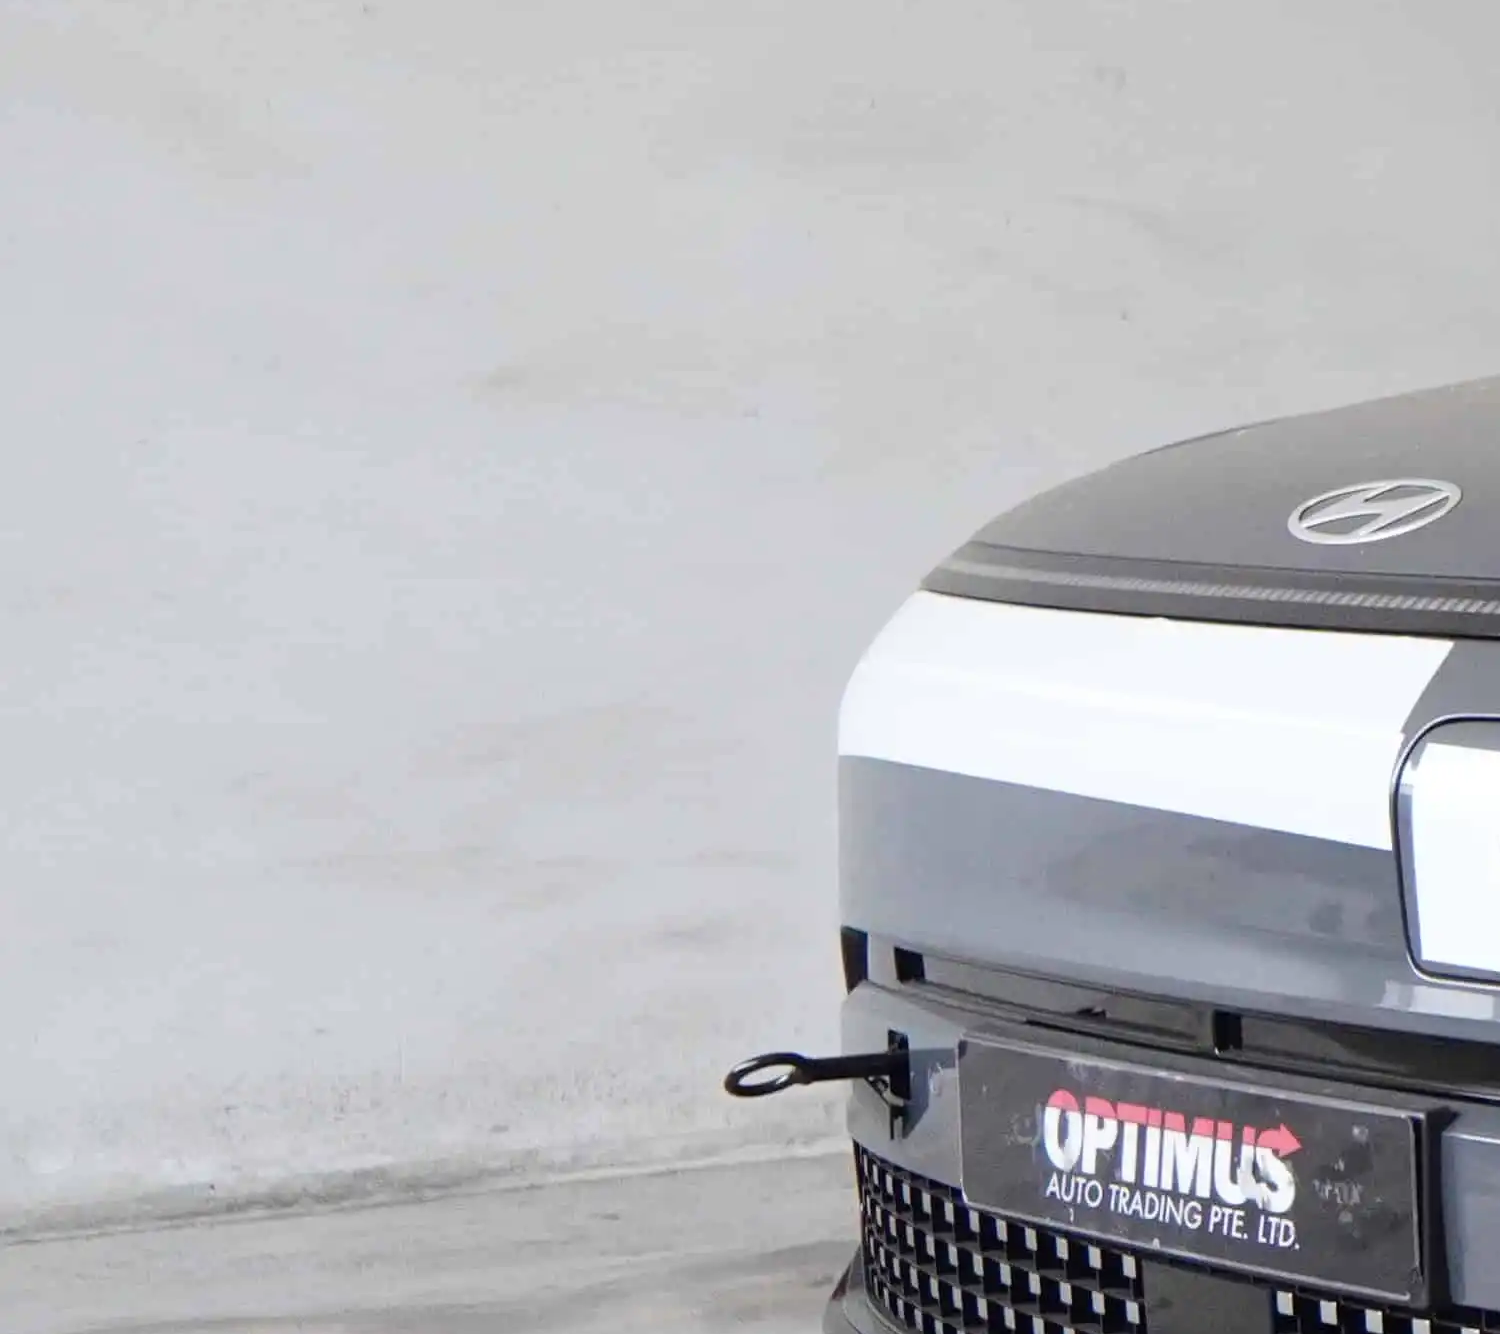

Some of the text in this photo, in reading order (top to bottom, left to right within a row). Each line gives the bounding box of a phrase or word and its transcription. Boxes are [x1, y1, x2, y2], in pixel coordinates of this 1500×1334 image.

[1044, 1089, 1301, 1213] OPTIMUS
[1046, 1173, 1300, 1250] AUTO TRADING PTE. LTD.
